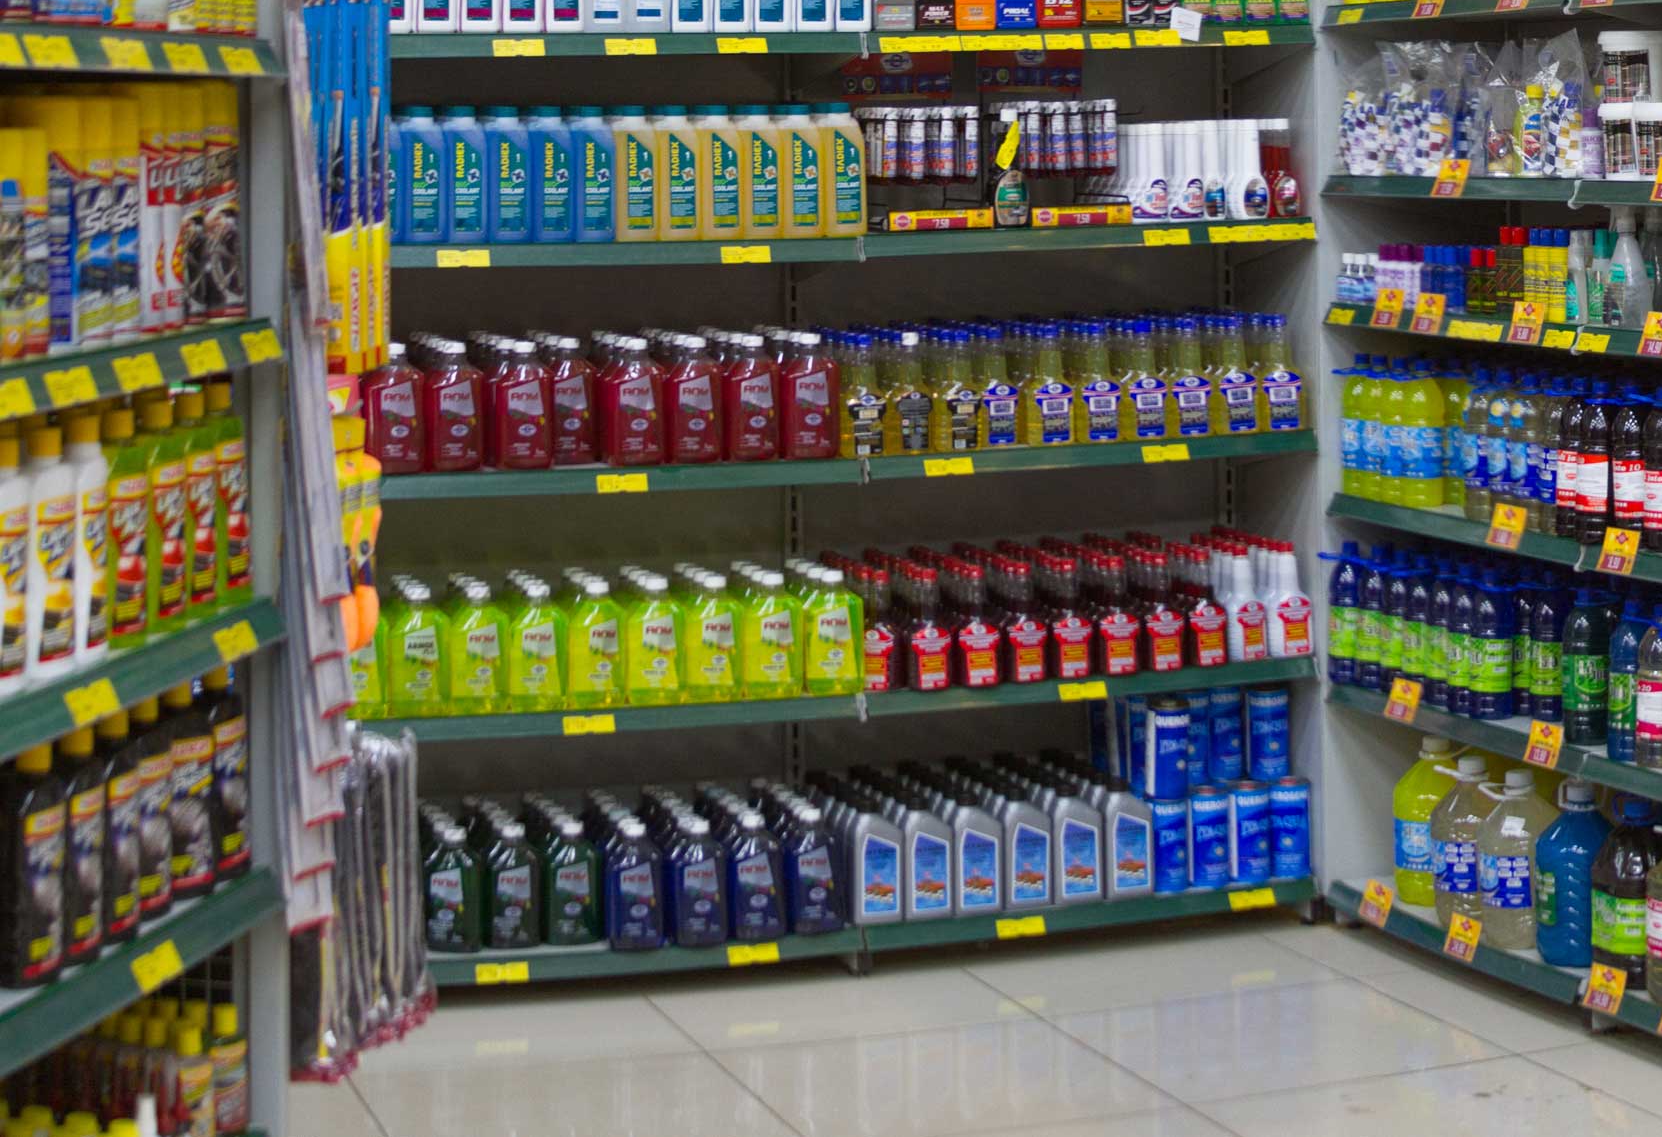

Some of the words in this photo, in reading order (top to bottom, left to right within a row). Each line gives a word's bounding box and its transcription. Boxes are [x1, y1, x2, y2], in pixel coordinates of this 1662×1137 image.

[455, 142, 465, 178] RADIEX
[500, 142, 510, 179] RADIEX
[586, 142, 595, 178] RADIEX
[628, 141, 638, 177] RADIEX
[714, 141, 722, 176] RADIEX
[753, 140, 762, 175] RADIEX
[836, 138, 845, 173] RADIEX
[1155, 714, 1190, 727] QUEROS
